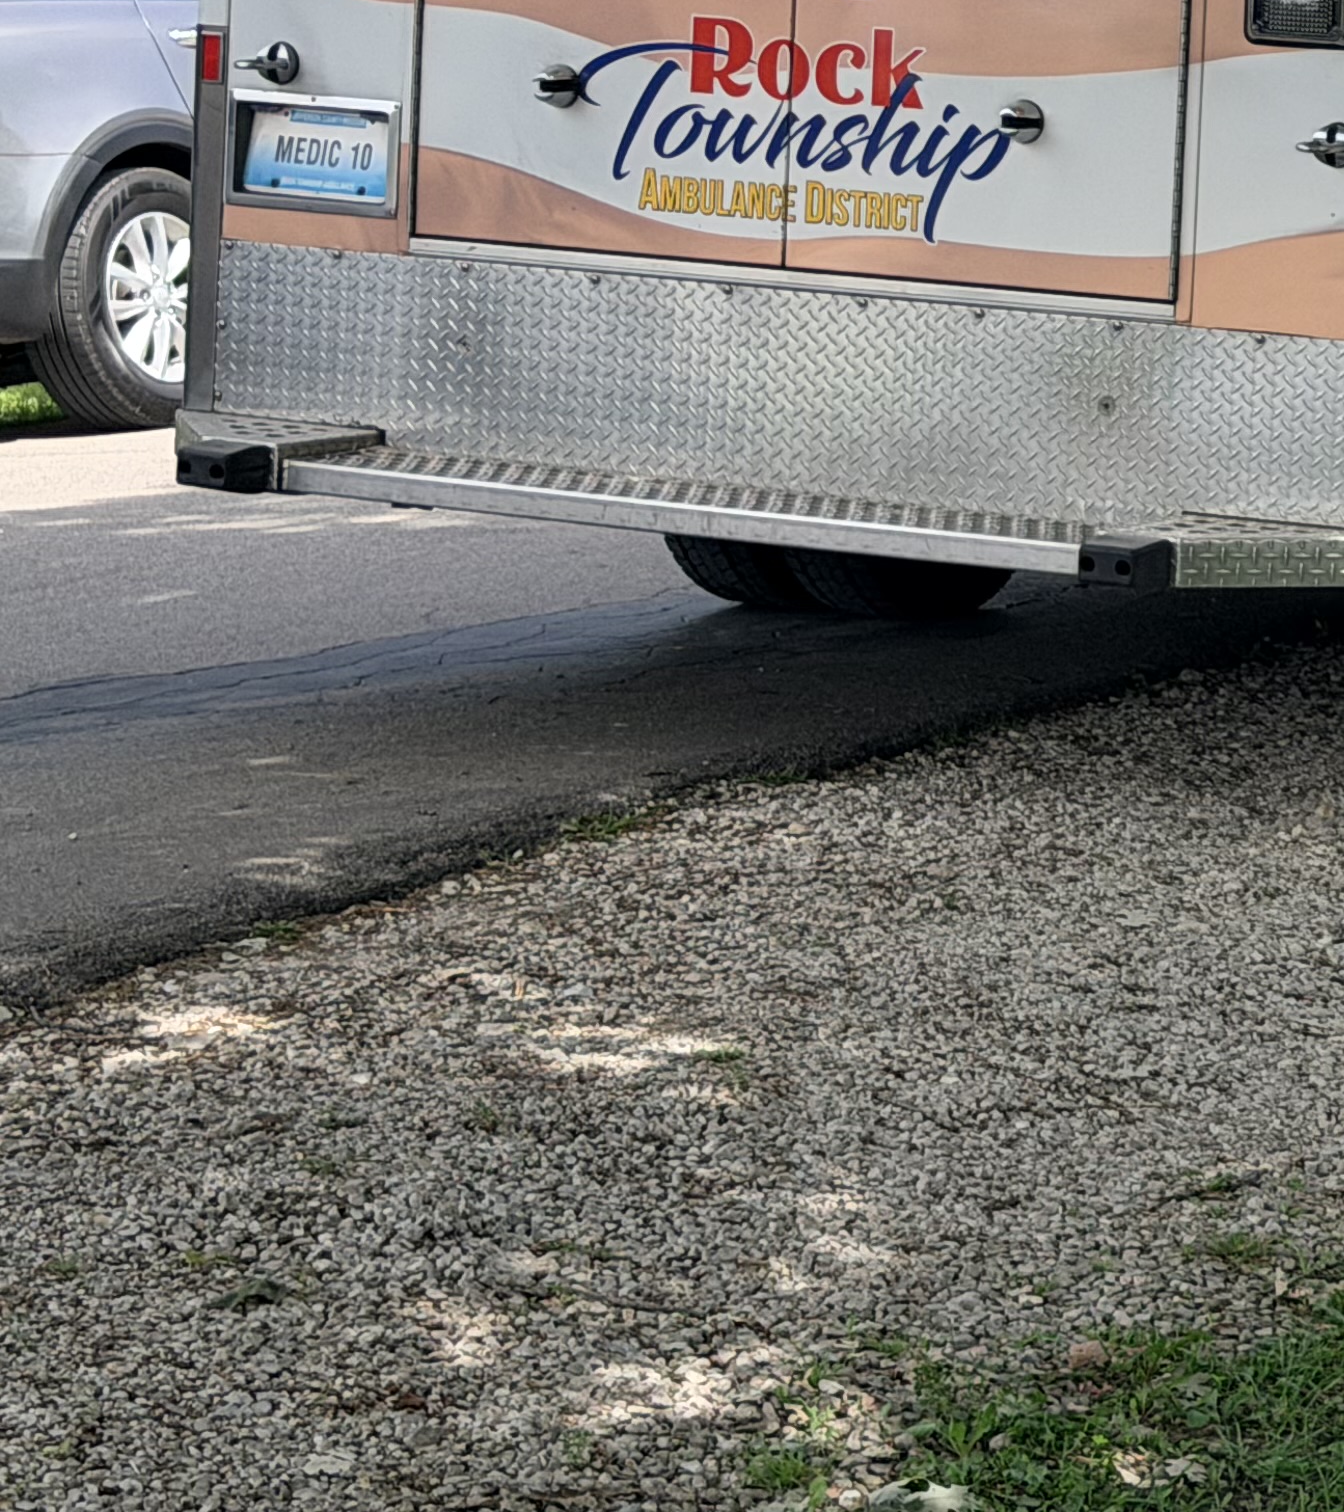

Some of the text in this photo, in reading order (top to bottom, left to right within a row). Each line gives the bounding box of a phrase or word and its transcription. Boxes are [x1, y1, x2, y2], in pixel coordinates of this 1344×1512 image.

[274, 134, 374, 172] MEDIC 10
[577, 39, 1014, 244] Township
